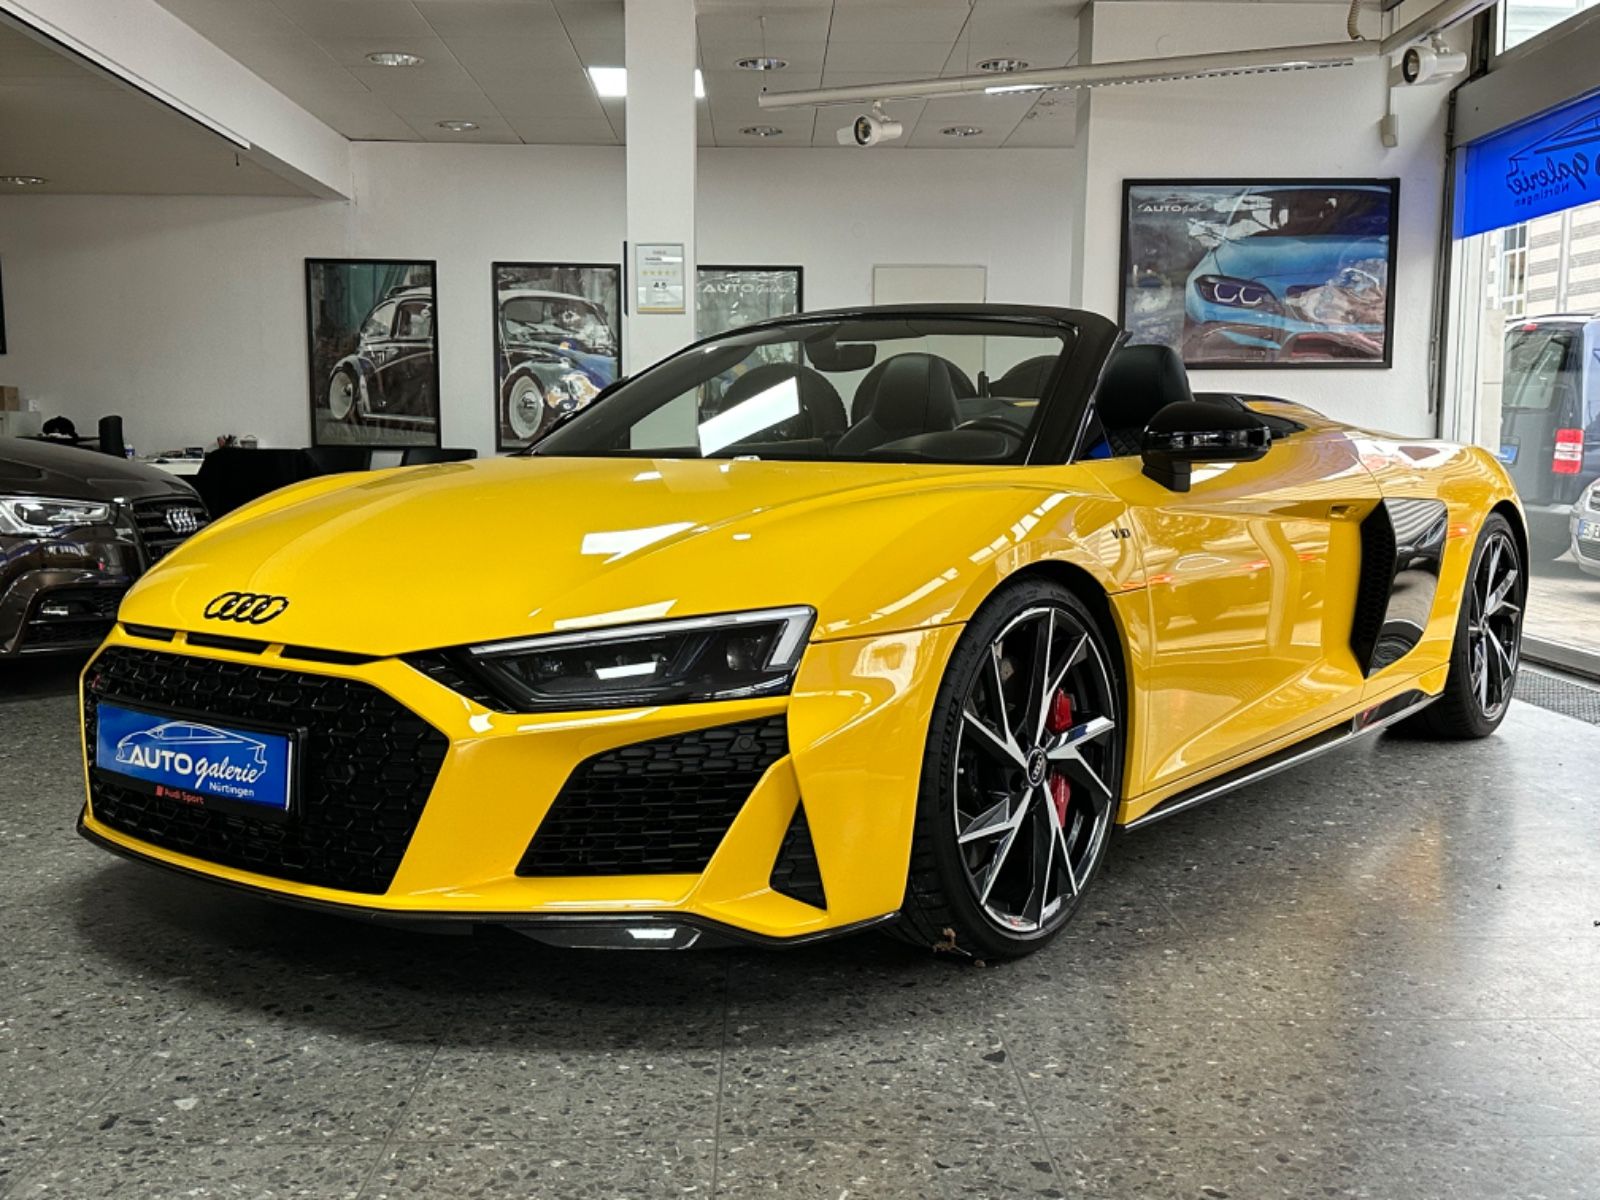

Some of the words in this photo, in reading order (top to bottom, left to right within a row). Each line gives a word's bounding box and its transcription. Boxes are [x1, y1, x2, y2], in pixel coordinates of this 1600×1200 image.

[1143, 204, 1182, 212] AUTO
[702, 283, 755, 293] AUTO
[128, 744, 194, 776] AUTO
[194, 756, 260, 790] galerie
